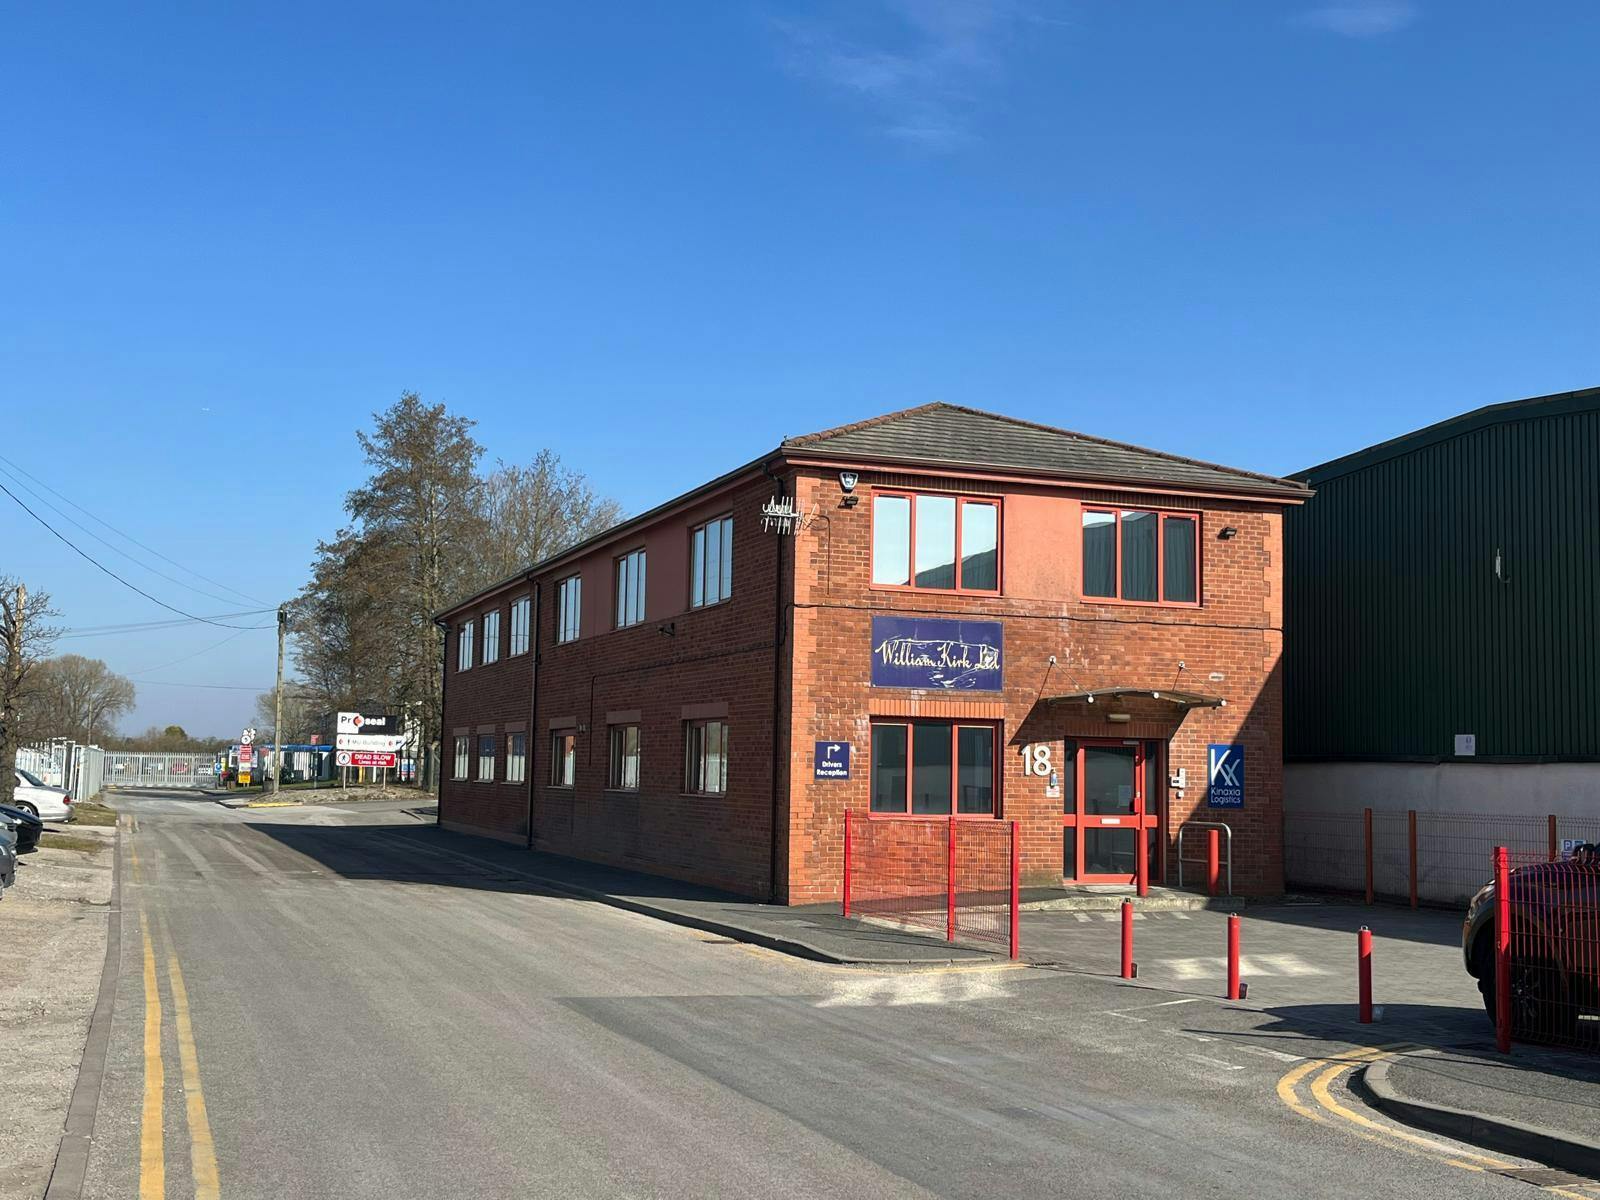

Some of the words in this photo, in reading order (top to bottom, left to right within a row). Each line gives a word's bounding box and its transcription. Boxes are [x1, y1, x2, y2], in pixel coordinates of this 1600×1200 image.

[875, 639, 936, 668] William
[937, 641, 972, 669] Kirk
[974, 644, 1000, 670] Ltd
[1021, 744, 1051, 776] 18
[816, 769, 848, 777] Reception
[1211, 787, 1240, 796] Kinaxia
[1211, 796, 1240, 805] Logistics
